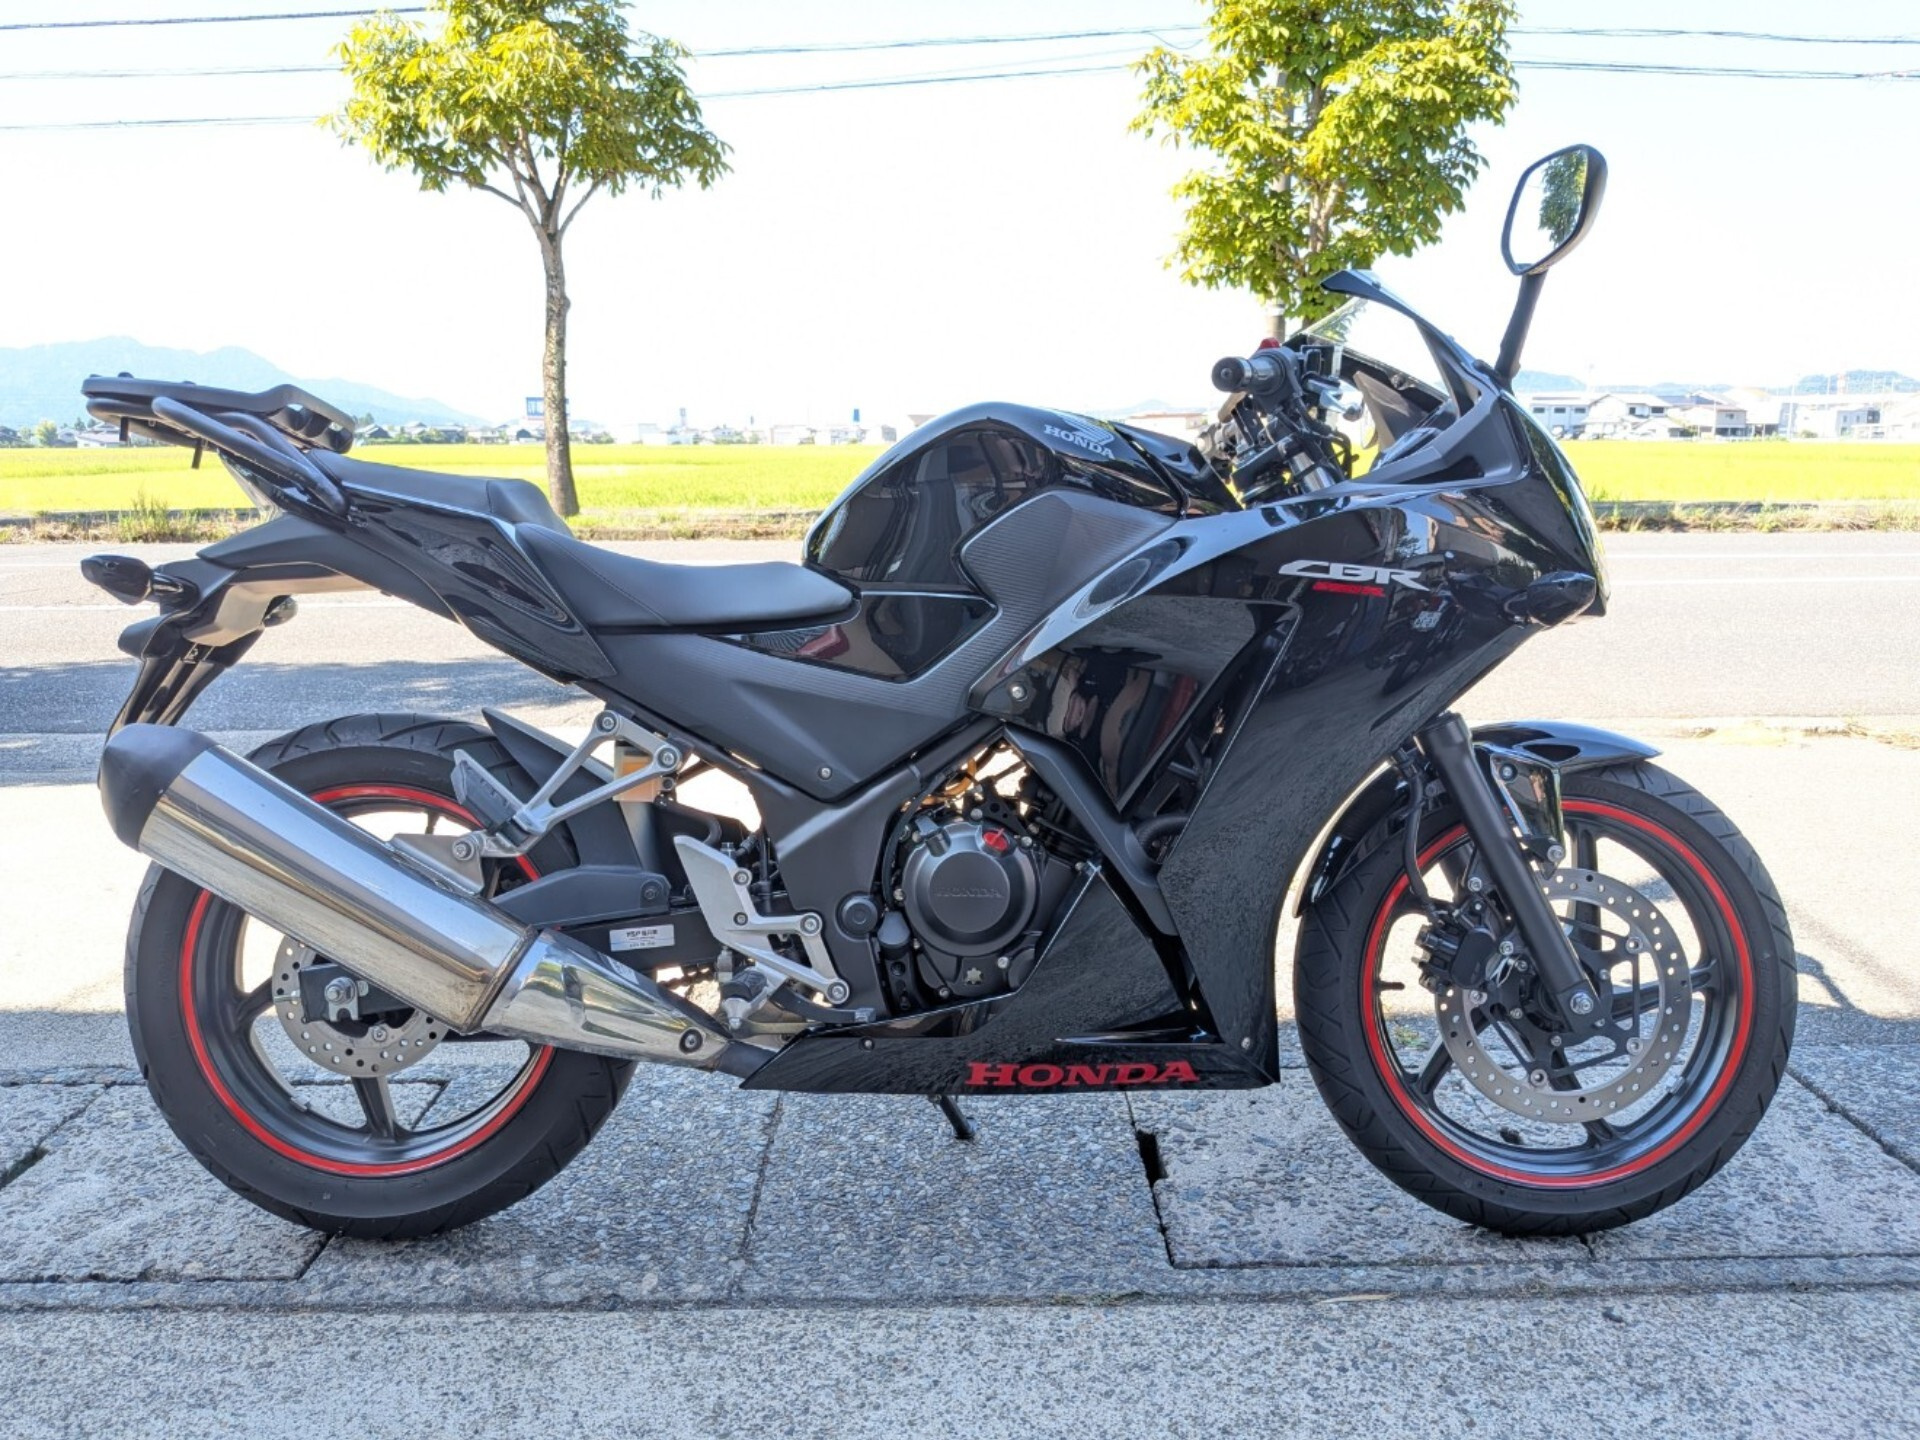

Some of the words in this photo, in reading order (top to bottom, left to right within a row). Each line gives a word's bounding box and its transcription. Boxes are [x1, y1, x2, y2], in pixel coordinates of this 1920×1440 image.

[1044, 424, 1116, 460] HONDA
[1278, 559, 1430, 592] CBR
[965, 1060, 1199, 1086] HONDA
